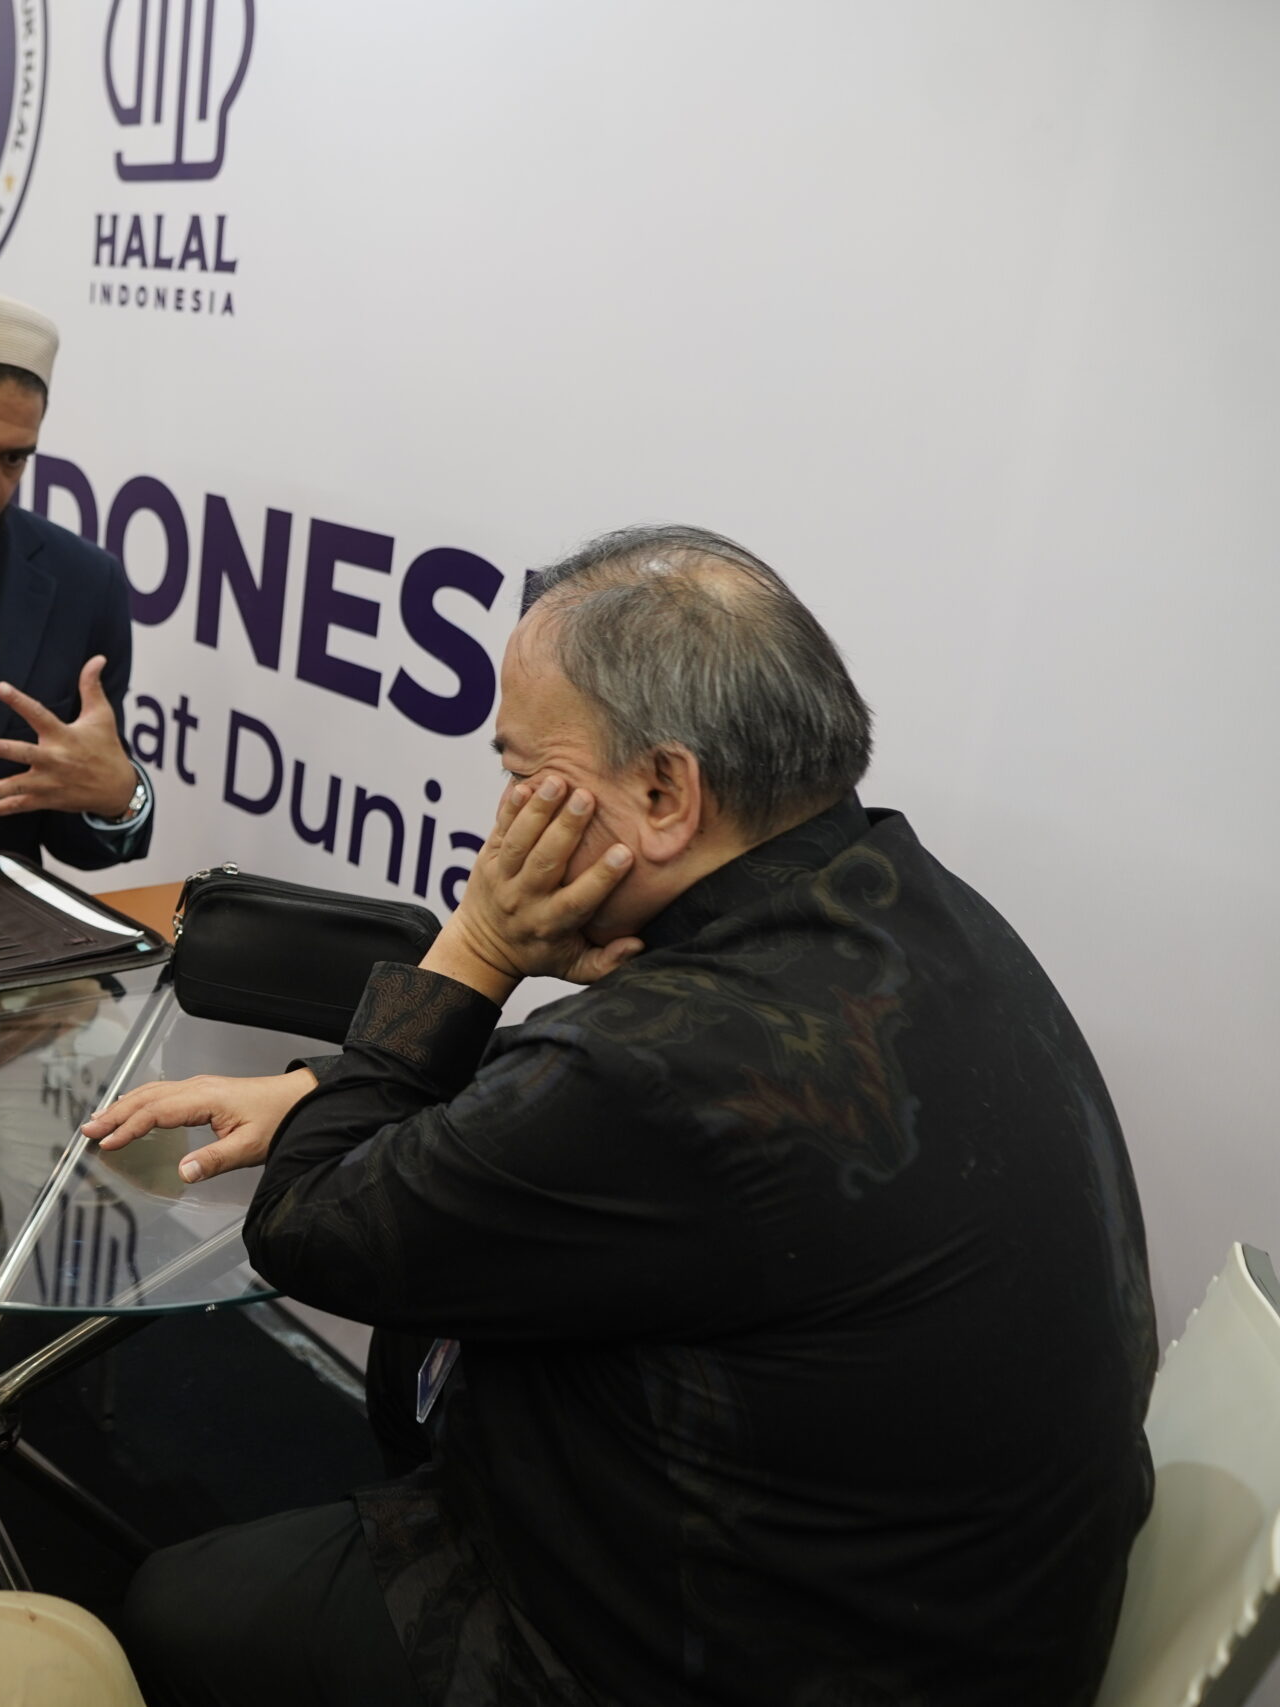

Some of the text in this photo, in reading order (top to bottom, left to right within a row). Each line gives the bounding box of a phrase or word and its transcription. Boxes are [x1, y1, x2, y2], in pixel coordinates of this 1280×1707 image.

[94, 214, 237, 273] HALAL
[90, 283, 234, 316] INDONESIA
[16, 453, 536, 736] DONES
[131, 693, 198, 786] at
